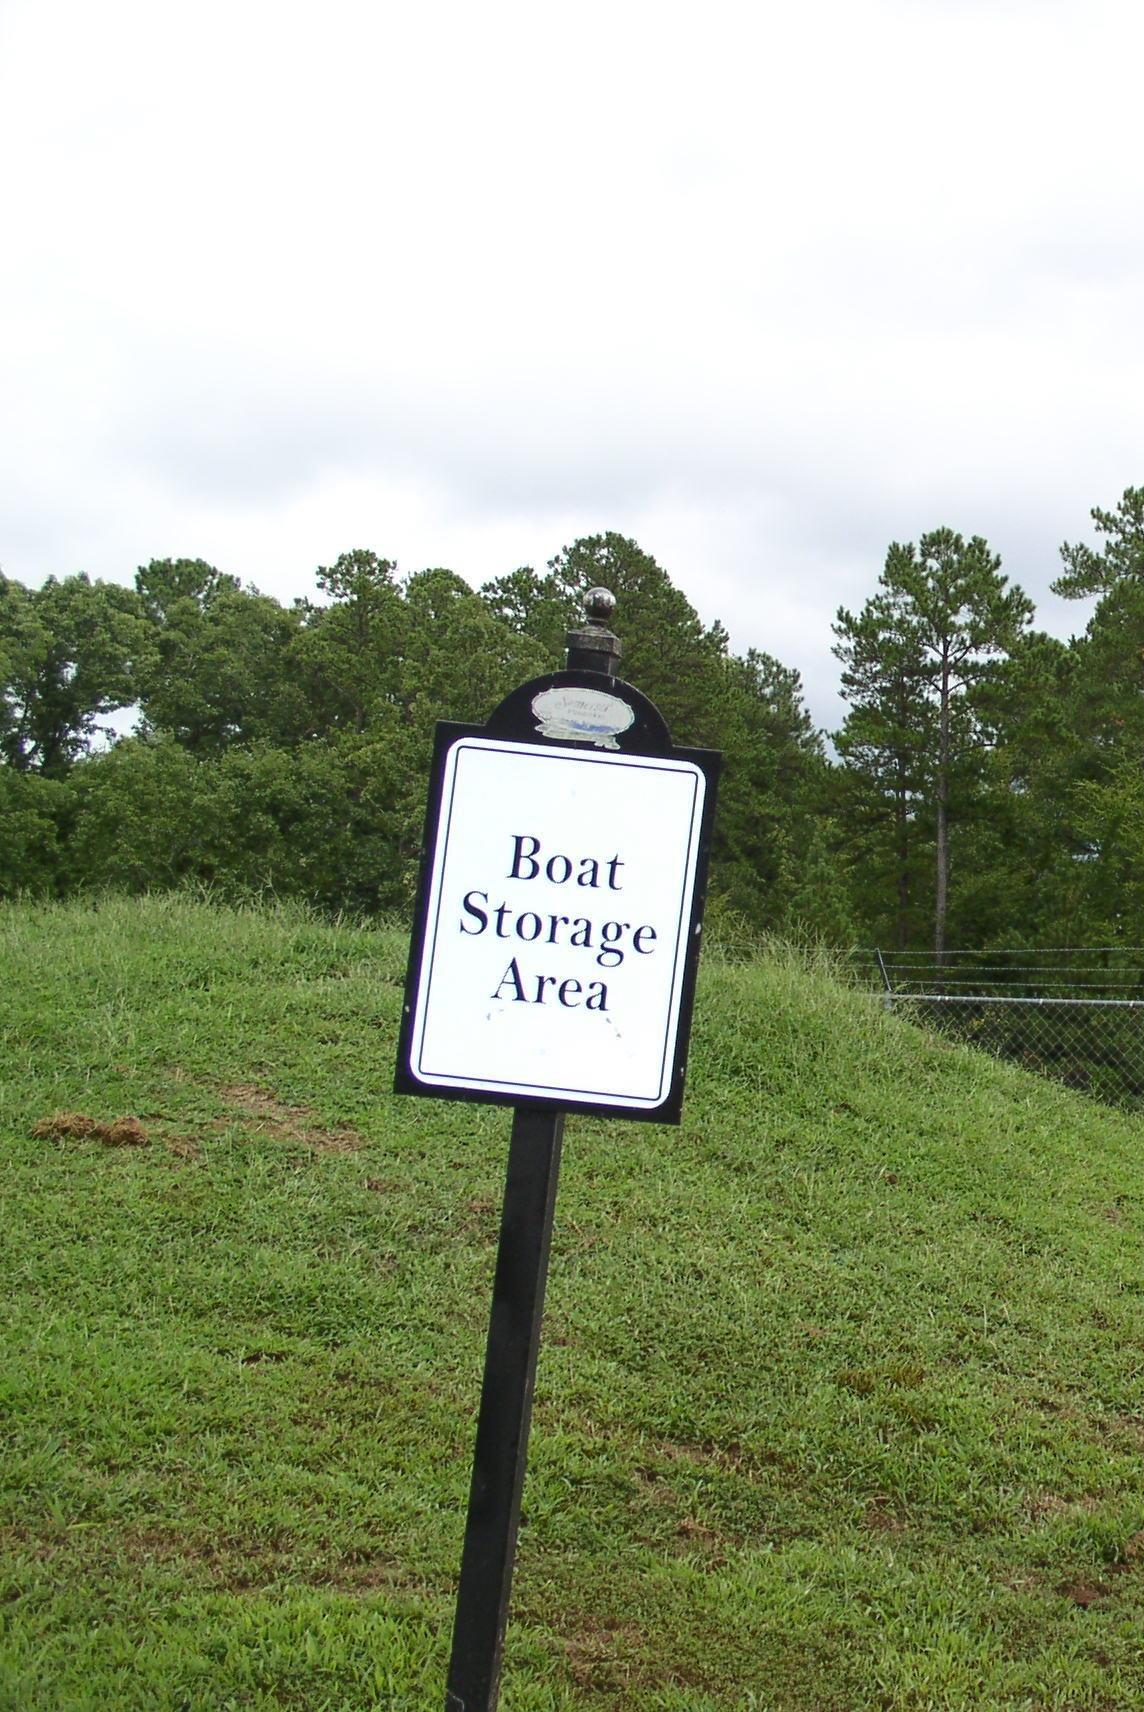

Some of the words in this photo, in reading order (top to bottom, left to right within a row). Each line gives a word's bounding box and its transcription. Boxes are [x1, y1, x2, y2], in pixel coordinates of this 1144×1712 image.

[506, 834, 625, 891] Boat
[459, 890, 657, 968] Storage
[490, 957, 609, 1012] Area
